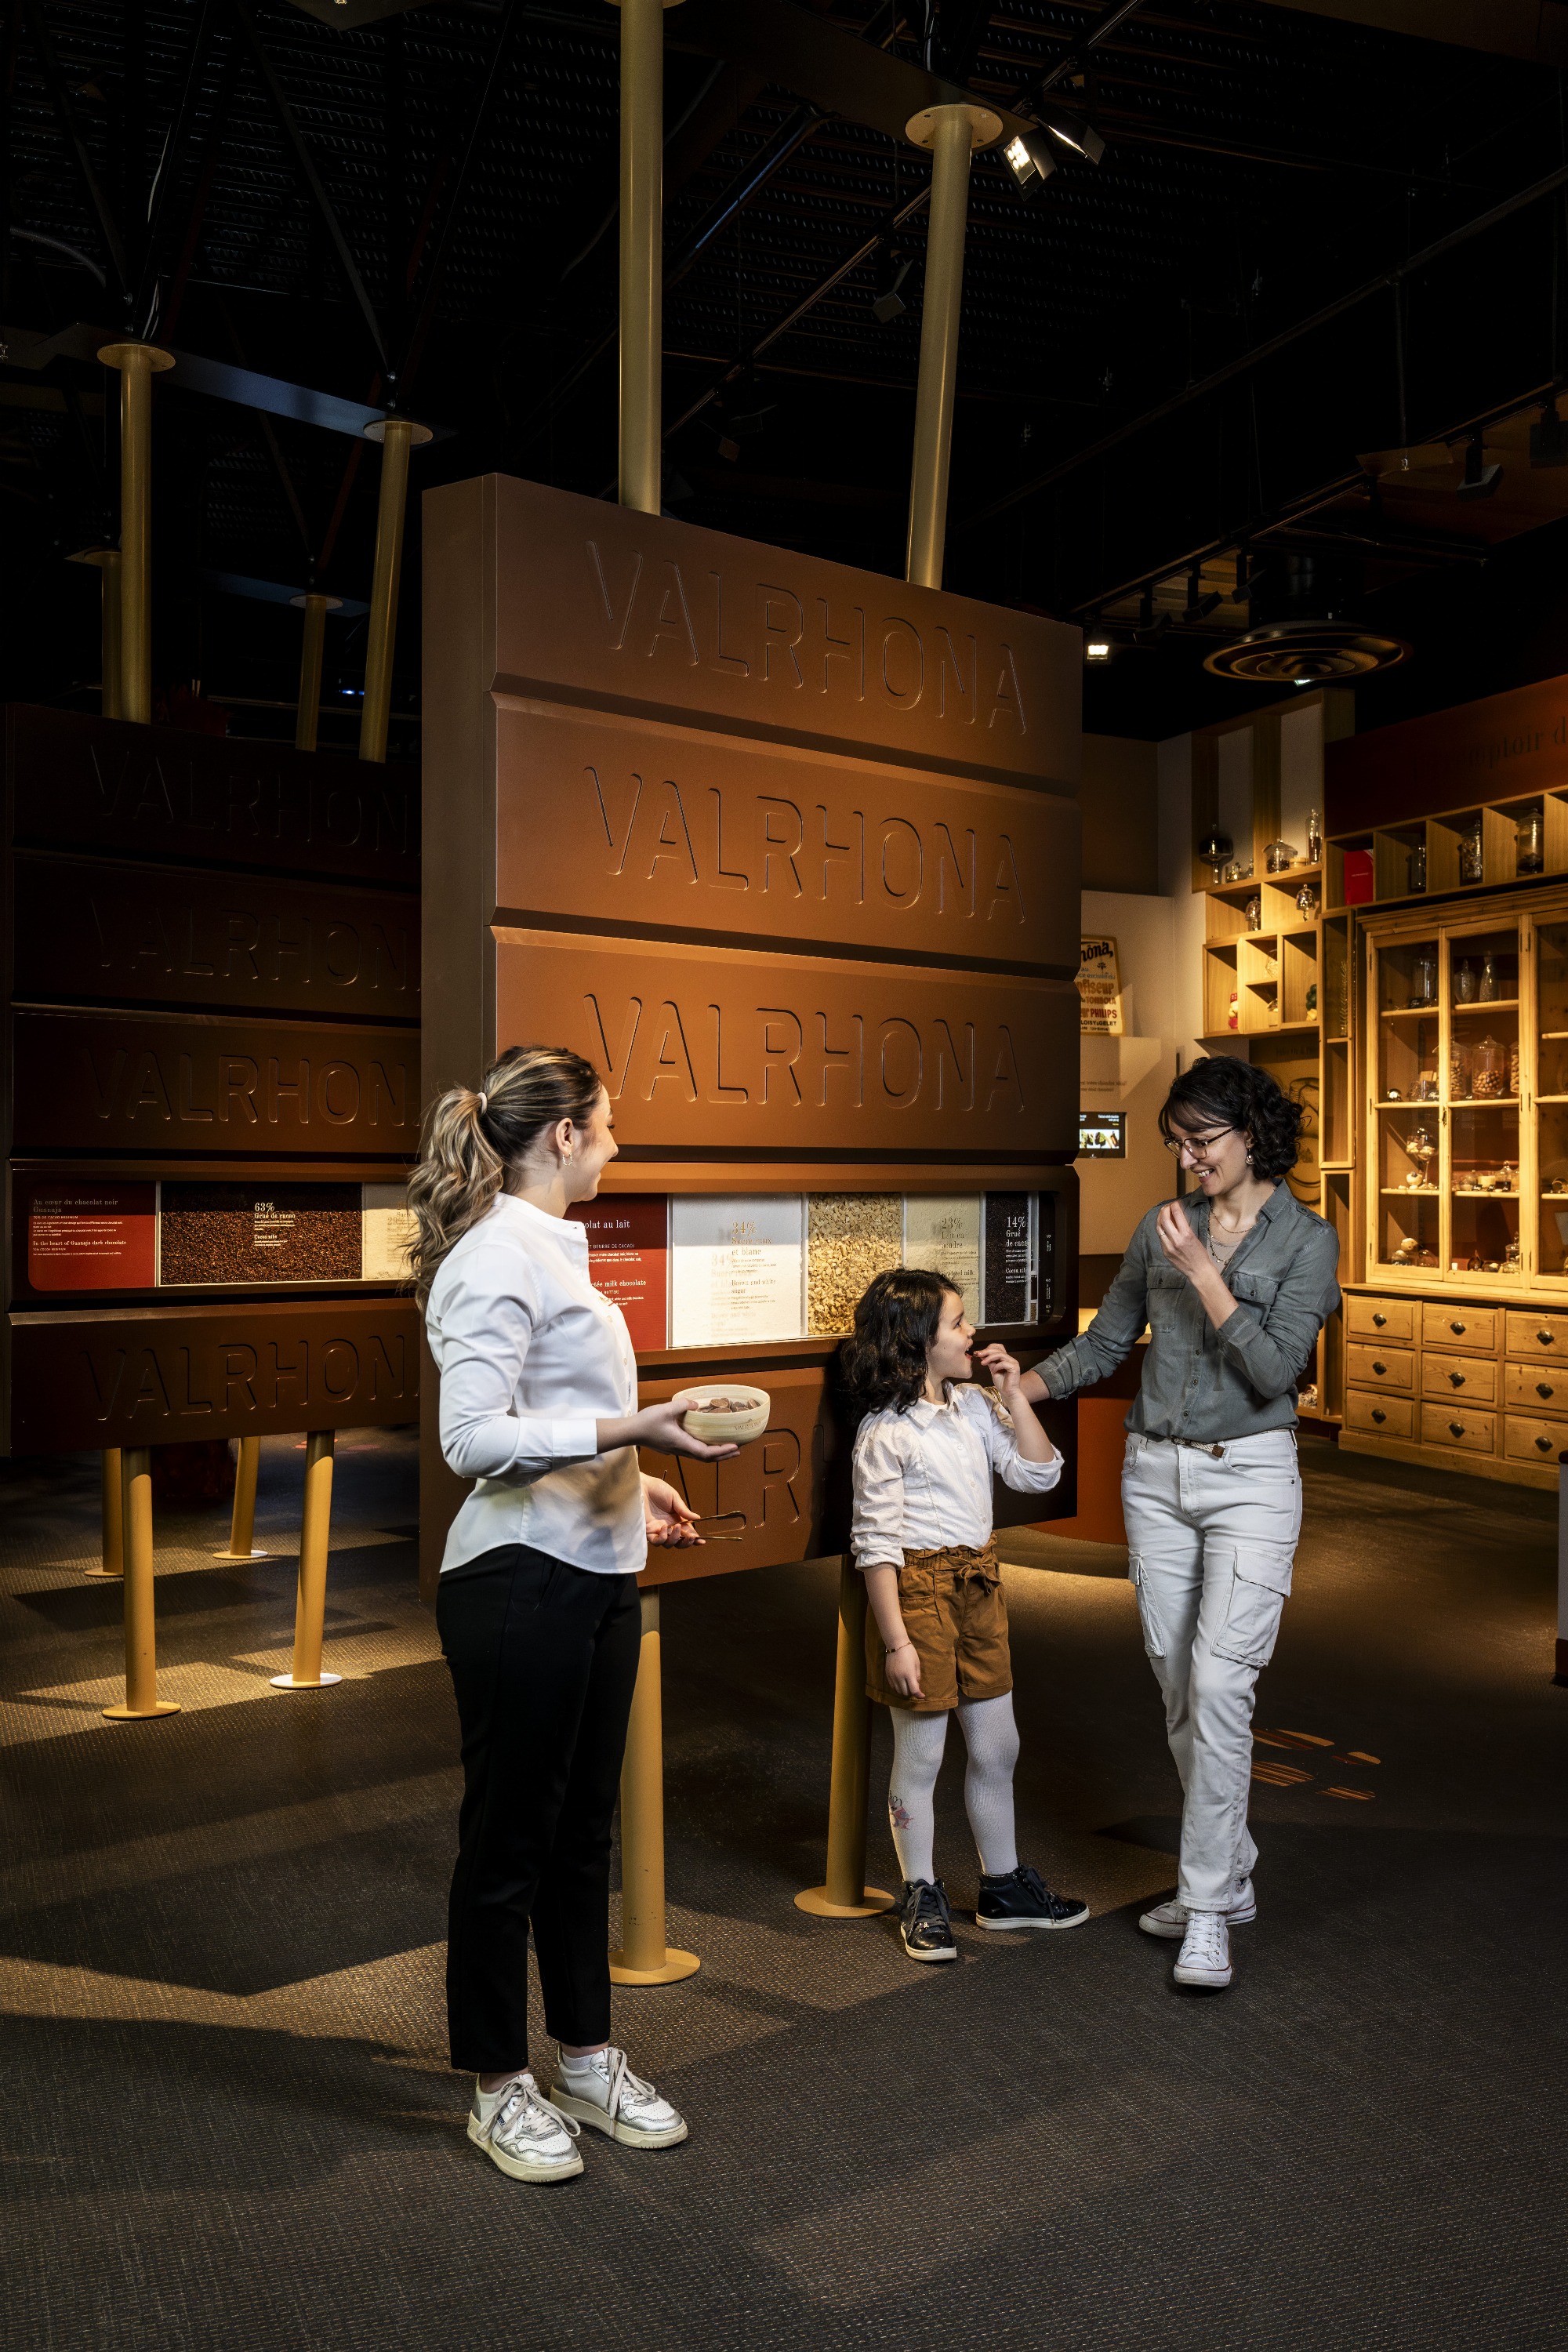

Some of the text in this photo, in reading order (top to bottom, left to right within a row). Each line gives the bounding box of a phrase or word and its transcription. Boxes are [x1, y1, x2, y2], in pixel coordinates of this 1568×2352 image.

[585, 539, 1028, 735] VALRHONA
[89, 744, 421, 857] VALRHON
[583, 766, 1027, 924] VALRHONA
[88, 894, 421, 991] VALRHON
[1091, 1008, 1117, 1018] PHILIPS
[583, 993, 1026, 1112] VALRHONA
[81, 1047, 421, 1127] VALRHON
[255, 1203, 274, 1213] 63%
[584, 1220, 601, 1229] olat
[615, 1219, 630, 1229] lait
[732, 1221, 757, 1236] 34%
[942, 1218, 963, 1231] 23%
[1006, 1216, 1026, 1230] 14%
[731, 1247, 739, 1256] et
[79, 1334, 421, 1421] VALRHON
